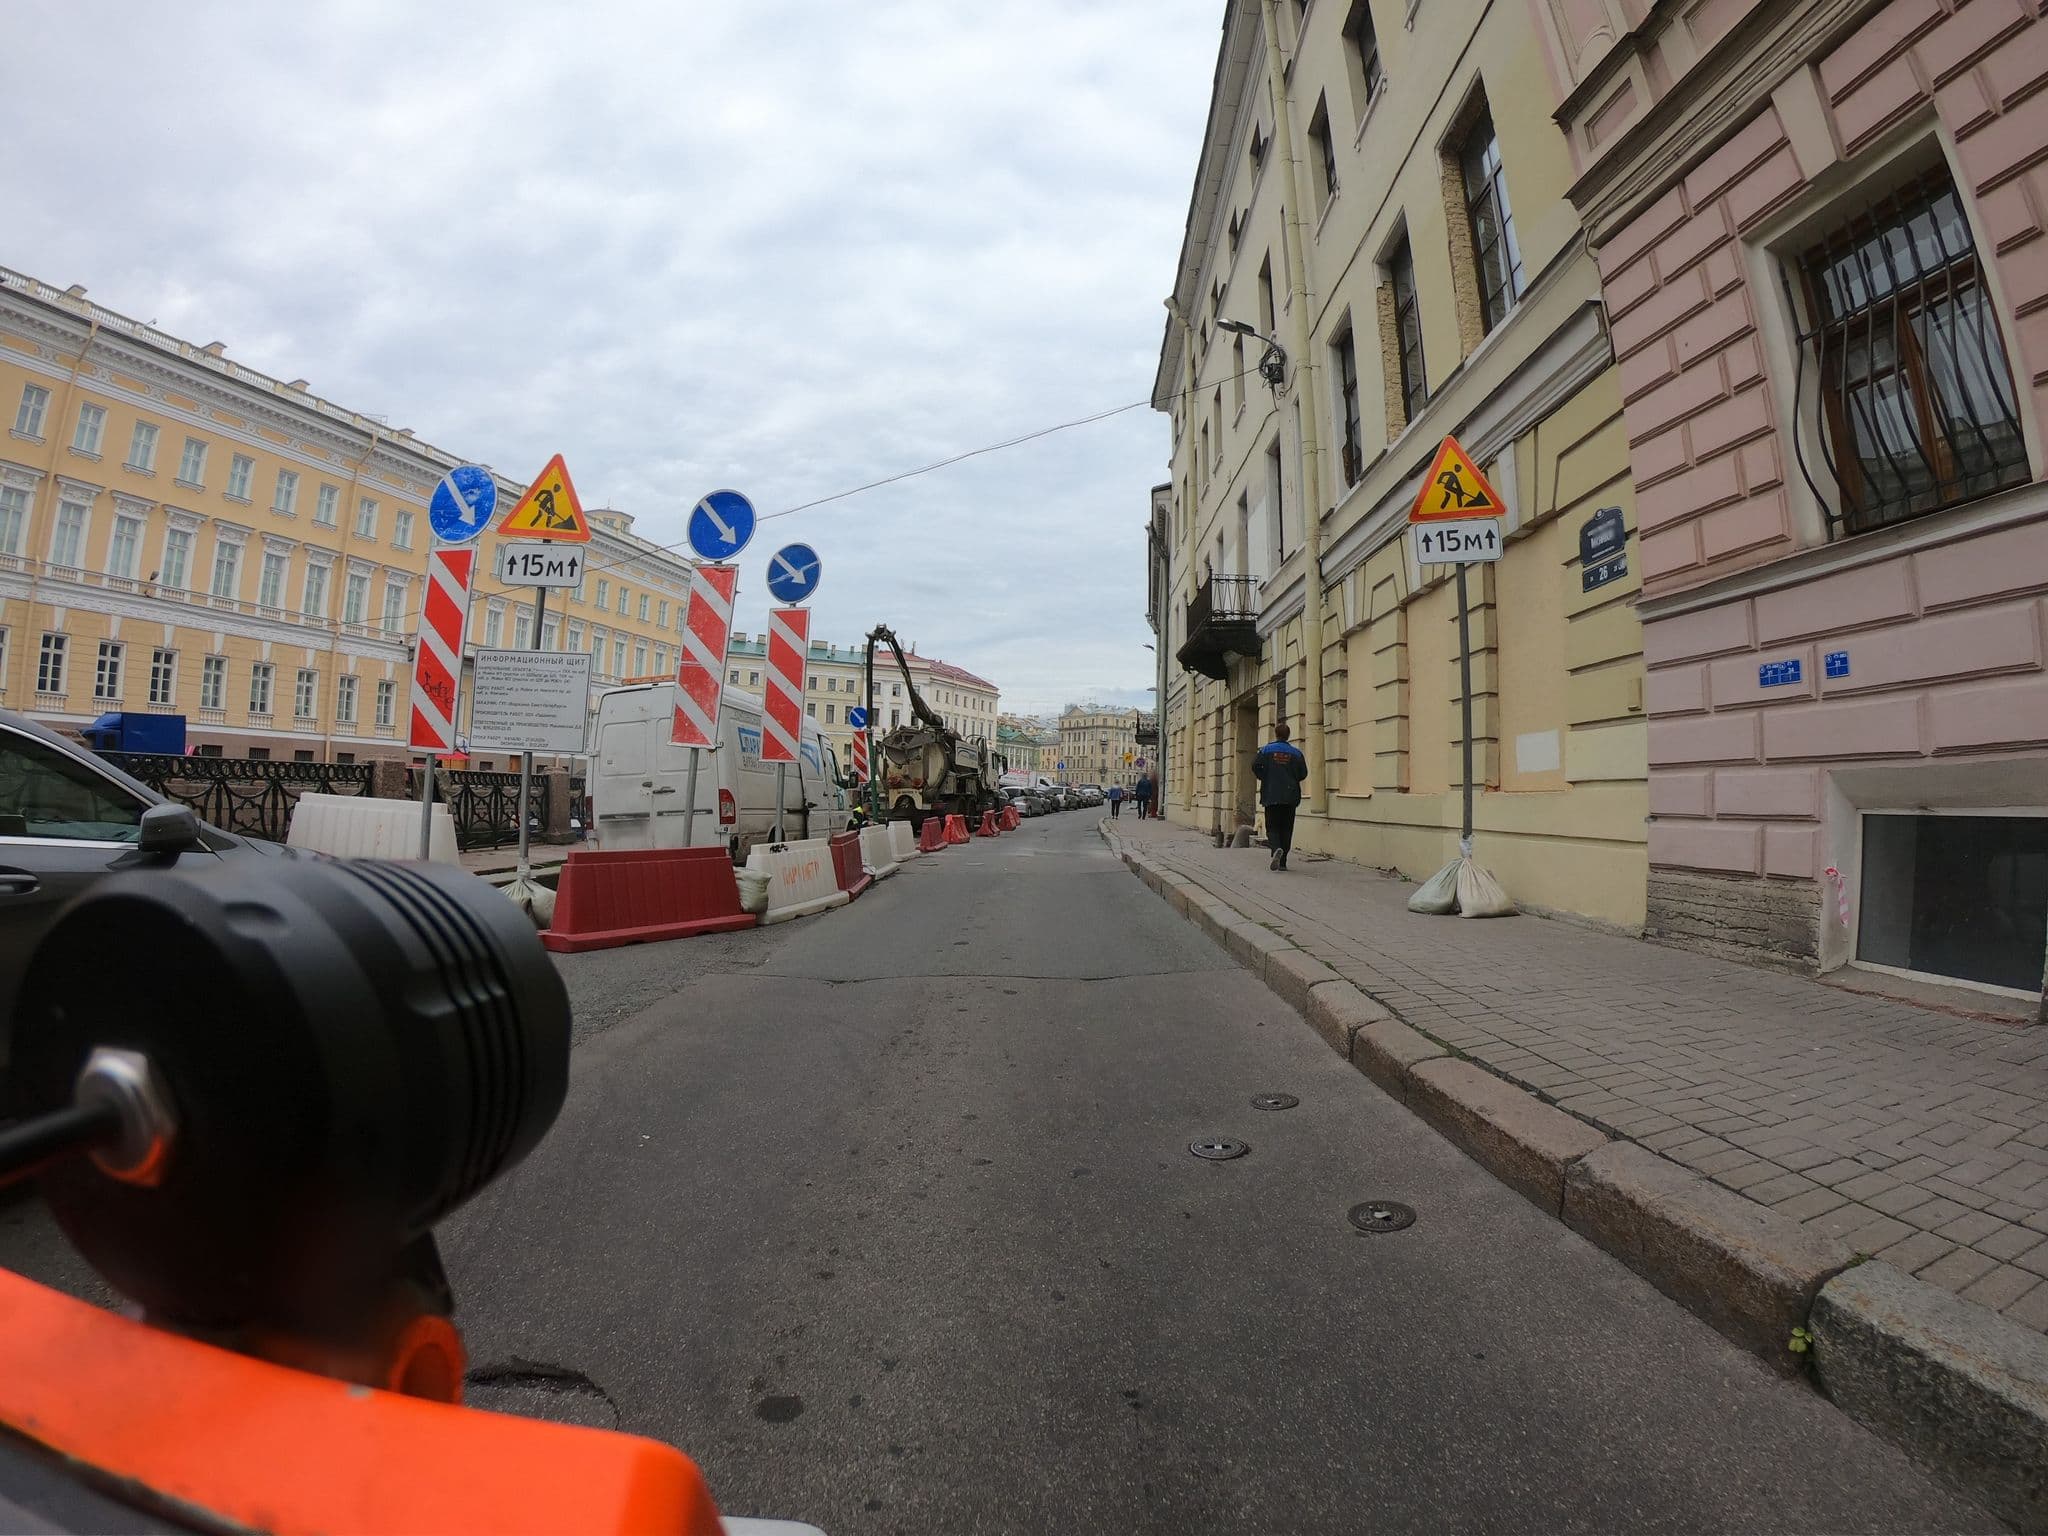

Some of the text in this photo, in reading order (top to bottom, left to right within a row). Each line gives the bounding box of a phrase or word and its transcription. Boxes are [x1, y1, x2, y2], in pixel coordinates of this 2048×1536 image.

[1599, 565, 1608, 580] 26
[480, 655, 586, 666] ИНФОРМАЦИОННЫЙ ЩИТ
